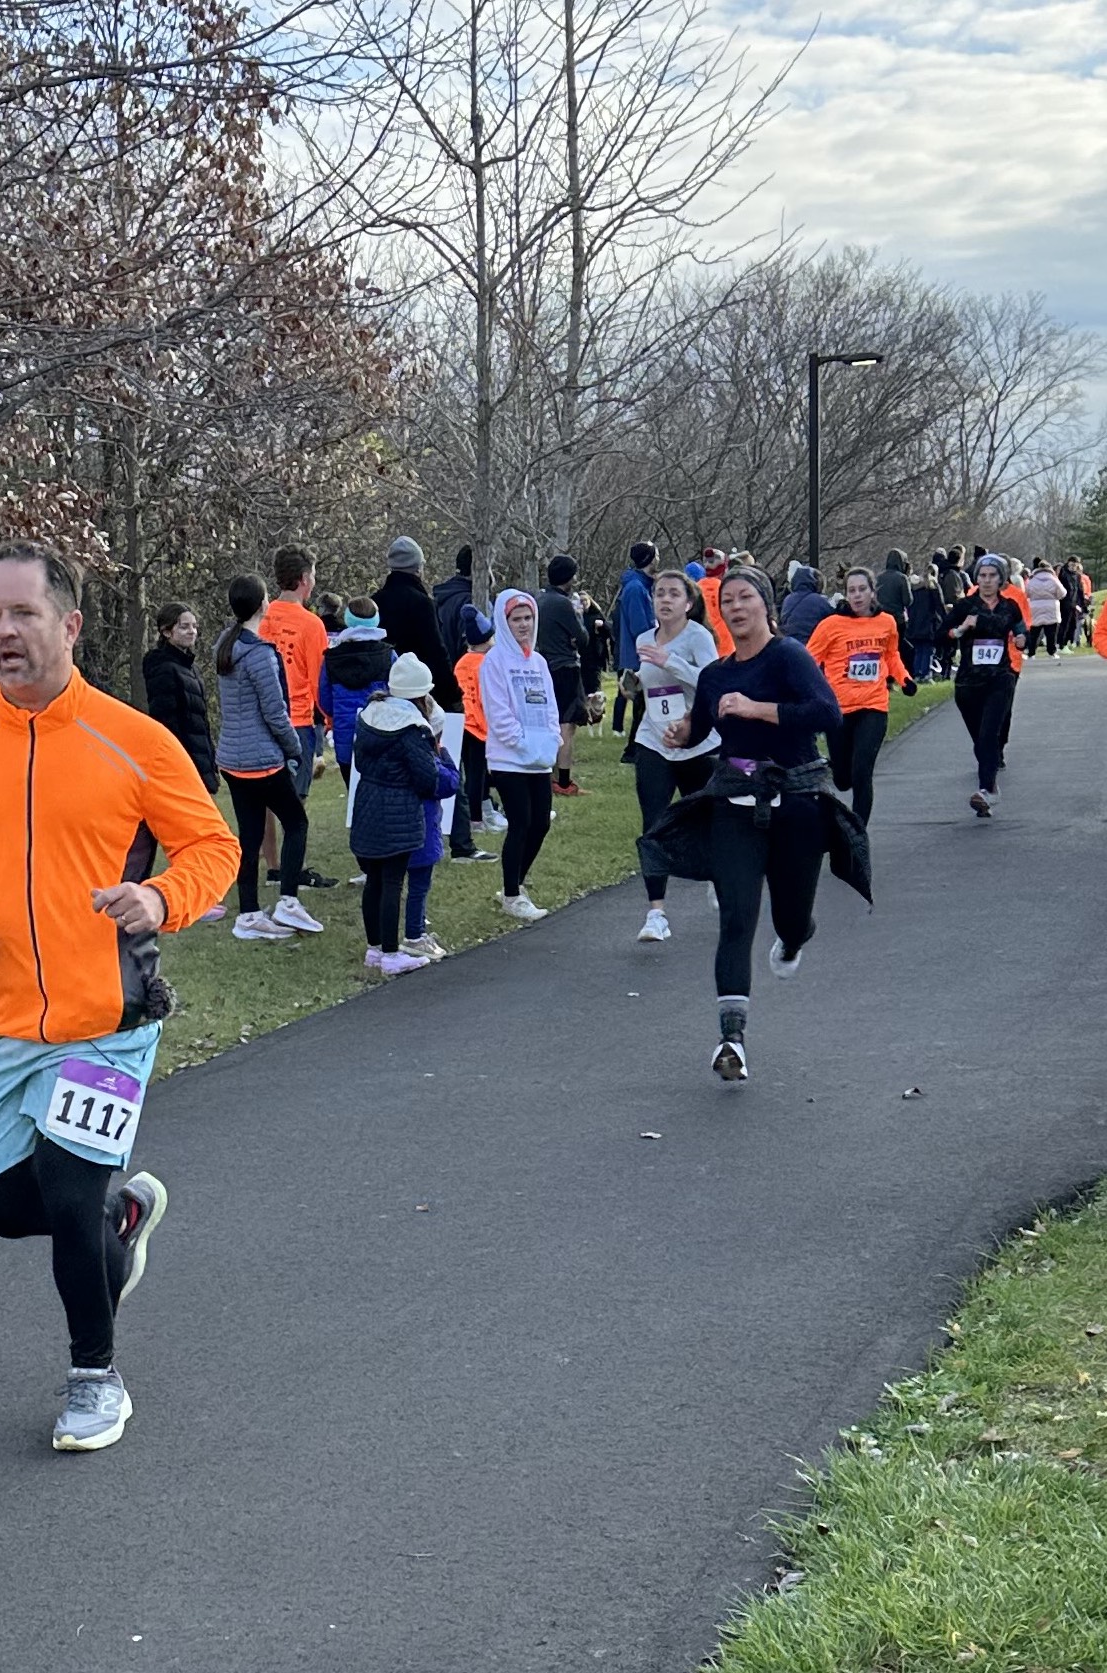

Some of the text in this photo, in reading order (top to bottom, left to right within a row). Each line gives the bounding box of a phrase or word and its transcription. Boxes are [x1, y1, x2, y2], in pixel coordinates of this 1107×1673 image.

[978, 648, 999, 660] 947
[661, 699, 669, 715] 8
[55, 1089, 133, 1141] 1117
